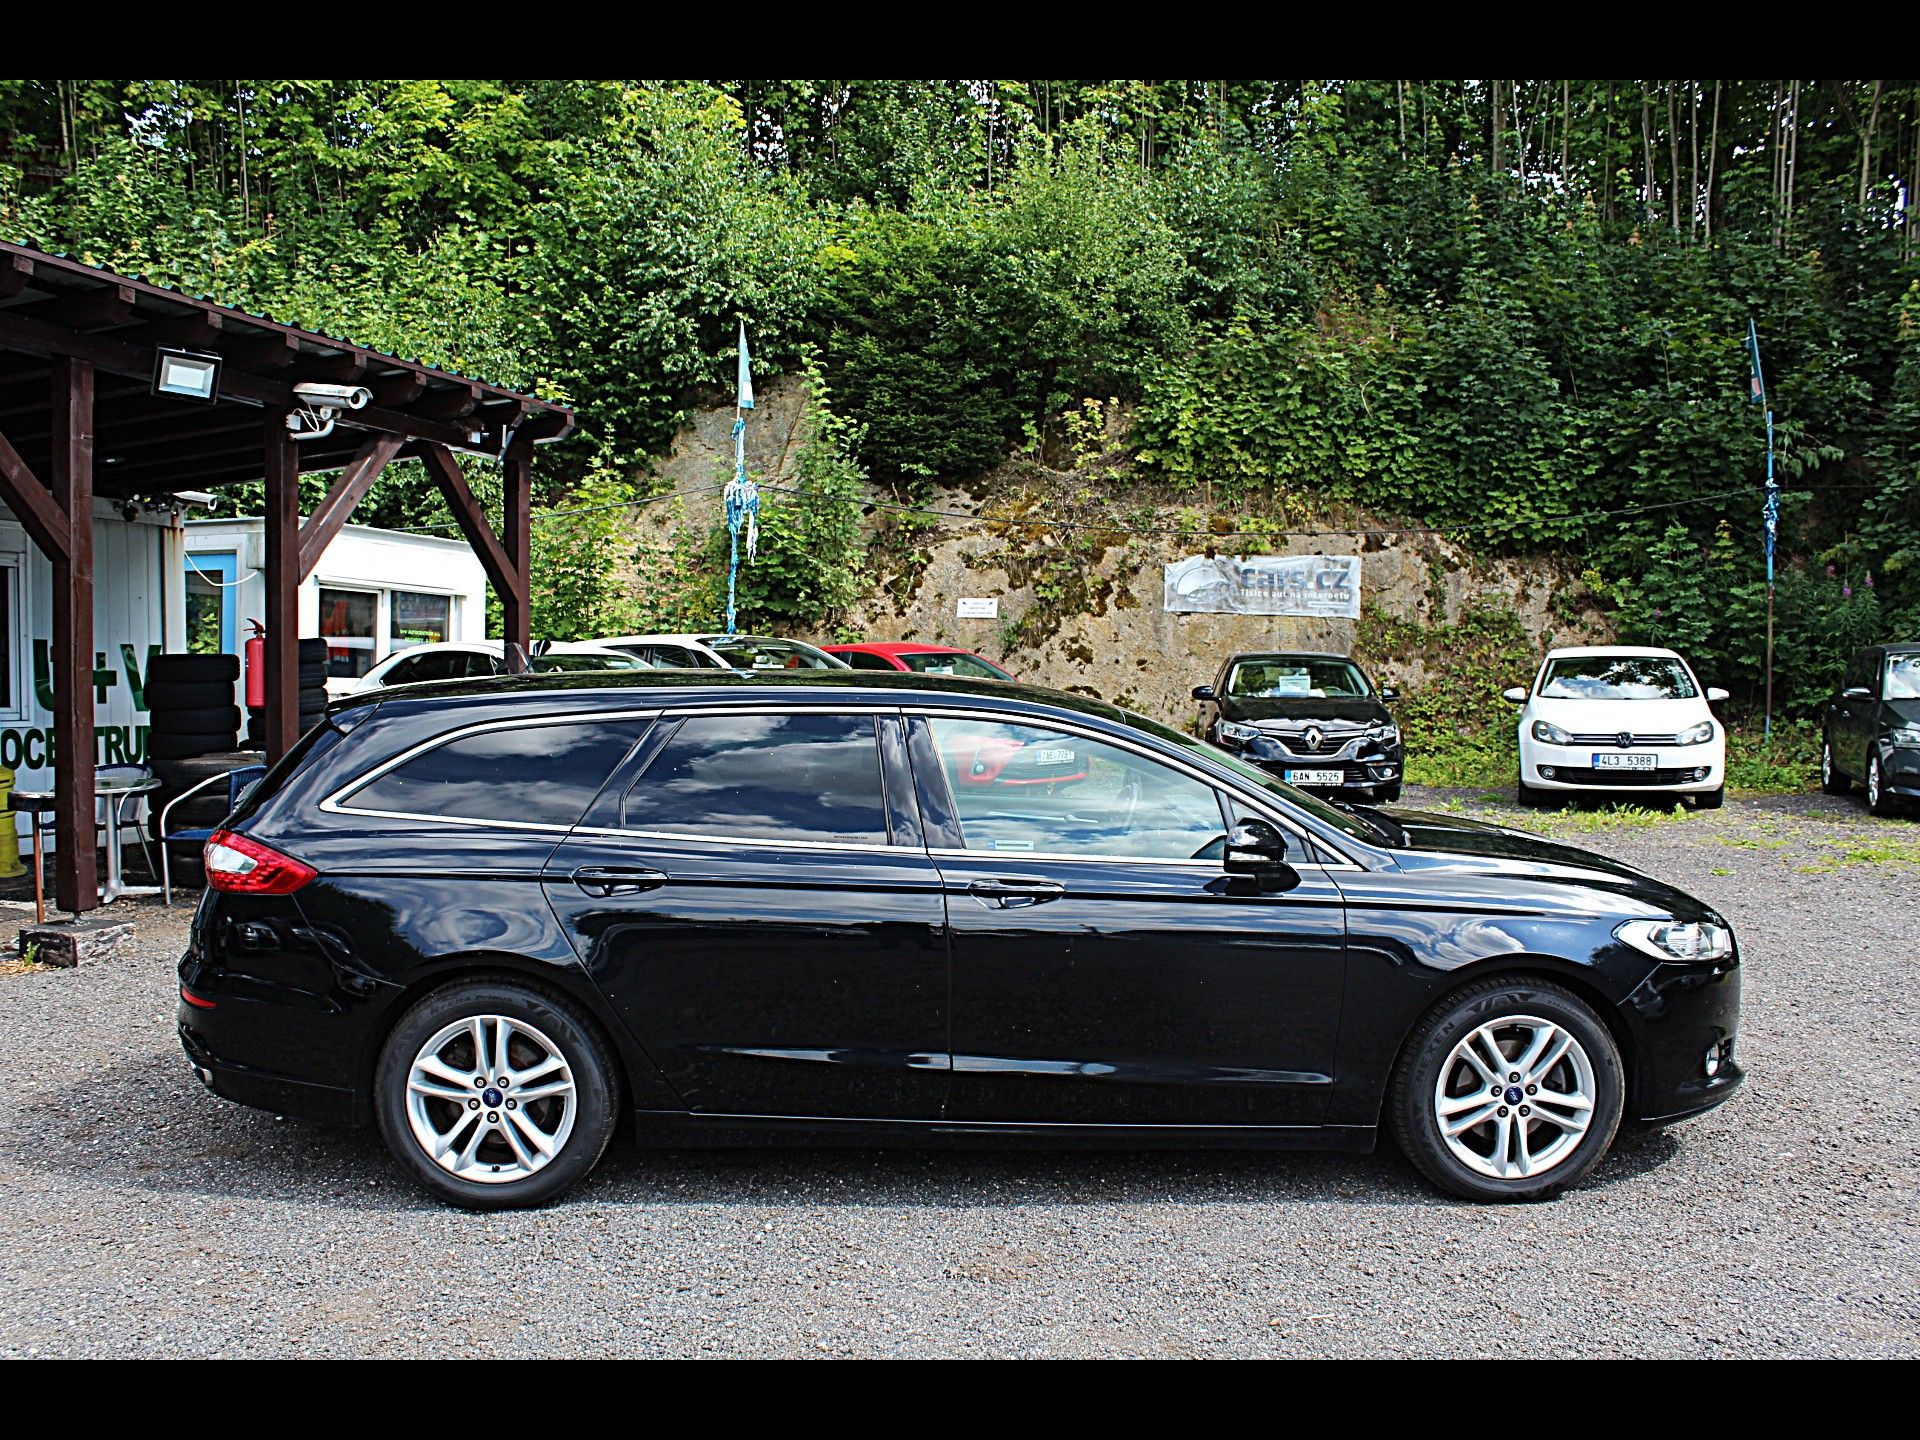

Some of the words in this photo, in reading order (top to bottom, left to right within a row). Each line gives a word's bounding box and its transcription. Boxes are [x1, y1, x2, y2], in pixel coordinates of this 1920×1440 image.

[1240, 568, 1350, 590] cars.cz
[1271, 590, 1287, 598] aut
[1304, 591, 1350, 600] internetu
[1601, 756, 1620, 766] 4L3
[1627, 756, 1652, 766] 5388
[1293, 772, 1310, 782] 6AN
[1316, 772, 1339, 782] 5525
